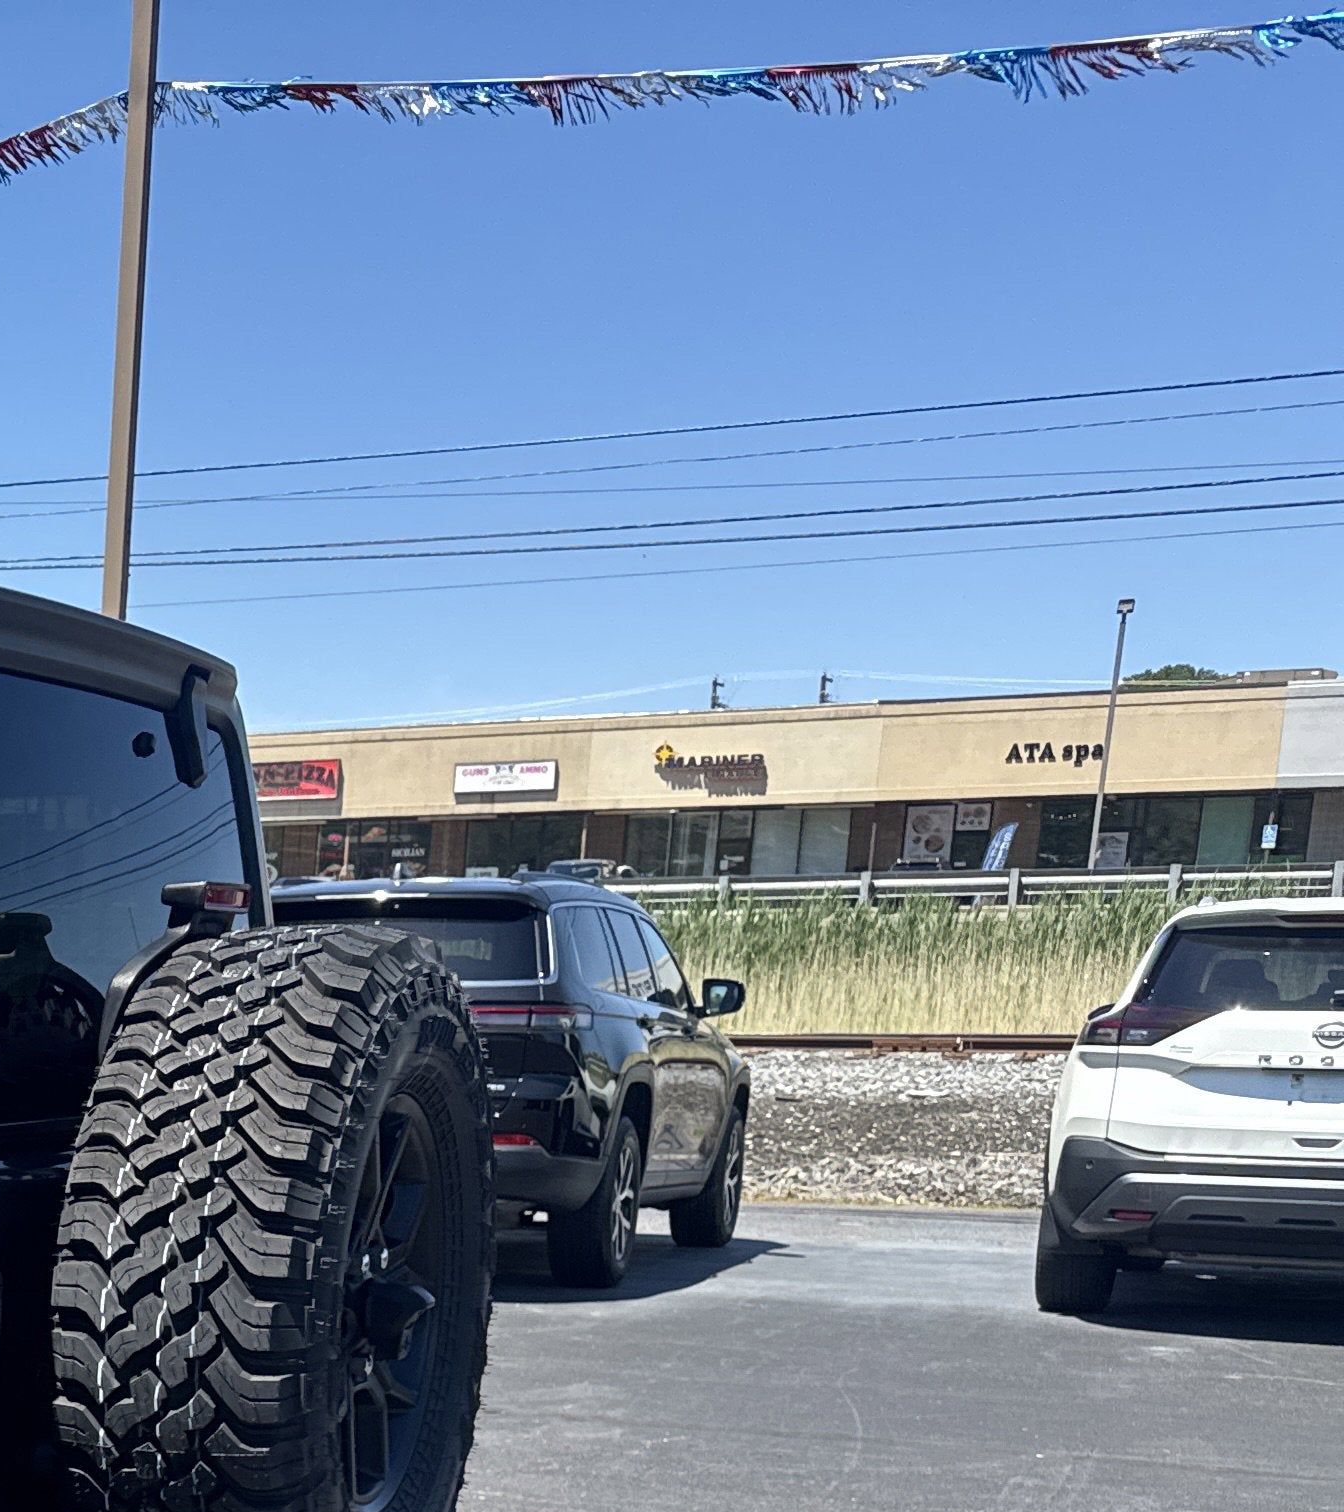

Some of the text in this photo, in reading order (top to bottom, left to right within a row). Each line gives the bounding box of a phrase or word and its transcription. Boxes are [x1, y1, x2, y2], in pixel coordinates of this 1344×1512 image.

[664, 753, 765, 769] MARINER
[1005, 742, 1104, 767] ATA spa
[462, 765, 549, 777] GUNS AMMO
